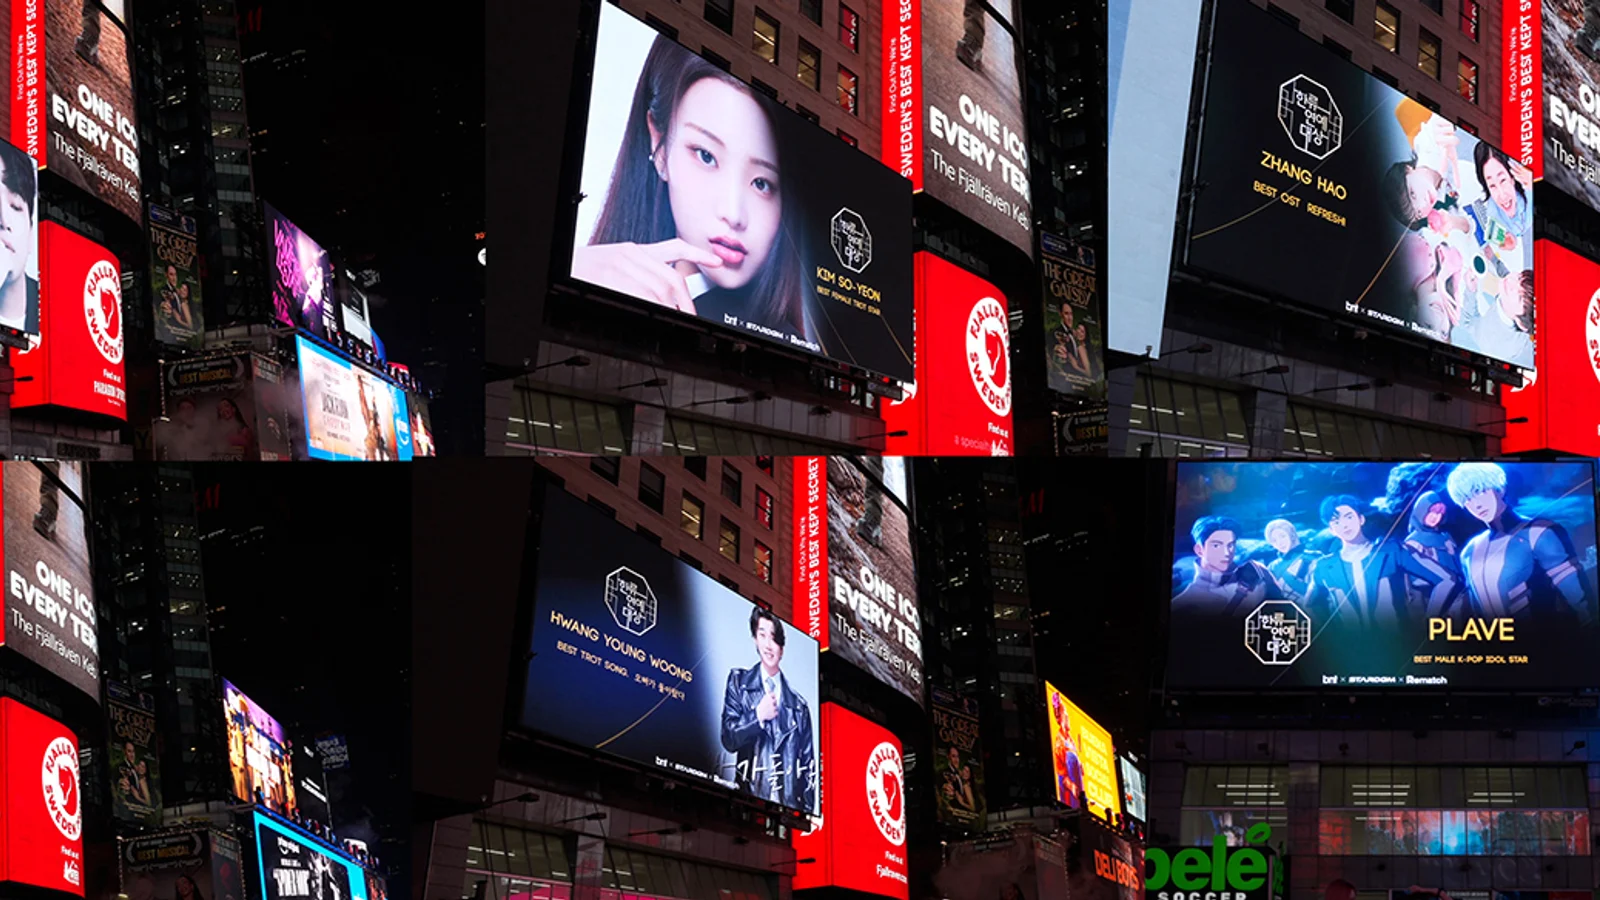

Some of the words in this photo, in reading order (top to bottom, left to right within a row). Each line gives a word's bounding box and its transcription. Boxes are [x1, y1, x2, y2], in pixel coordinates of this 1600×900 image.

[26, 23, 37, 57] KEPT
[899, 24, 912, 59] KEPT
[1520, 14, 1532, 49] KEPT
[26, 58, 38, 89] BEST
[899, 65, 913, 96] BEST
[1520, 54, 1533, 86] BEST
[26, 88, 38, 156] SWEDEN'S
[52, 93, 109, 152] EVERY
[78, 84, 113, 127] ONE
[959, 94, 1000, 145] ONE
[899, 99, 914, 178] SWEDEN'S
[929, 105, 996, 172] EVERY
[1520, 88, 1533, 165] SWEDEN'S
[53, 131, 75, 161] The
[1551, 137, 1576, 169] The
[931, 149, 955, 182] The
[1260, 150, 1313, 185] ZHANG
[1317, 175, 1347, 200] HAO
[1253, 180, 1278, 198] BEST
[1280, 192, 1301, 207] OST
[151, 227, 168, 247] THE
[817, 266, 836, 284] KIM
[838, 275, 881, 303] SO-YEON
[1042, 259, 1062, 281] THE
[817, 285, 830, 296] BEST
[868, 305, 881, 316] STAR
[807, 458, 819, 503] SECRET
[808, 506, 819, 539] KEPT
[808, 540, 820, 567] BEST
[36, 561, 72, 601] ONE
[860, 566, 896, 609] ONE
[10, 570, 67, 628] EVERY
[809, 568, 820, 637] SWEDEN'S
[834, 575, 892, 633] EVERY
[12, 608, 33, 636] The
[835, 612, 858, 642] The
[1428, 617, 1516, 642] PLAVE
[550, 610, 600, 642] HWANG
[603, 633, 646, 663] YOUNG
[650, 654, 694, 683] WOONG
[557, 640, 578, 656] BEST
[581, 650, 602, 666] TROT
[1413, 655, 1432, 664] BEST
[1435, 655, 1456, 664] MALE
[1457, 655, 1484, 664] K-POP
[1485, 655, 1506, 664] IDOL
[1508, 655, 1529, 664] STAR
[1405, 674, 1448, 685] Rematch
